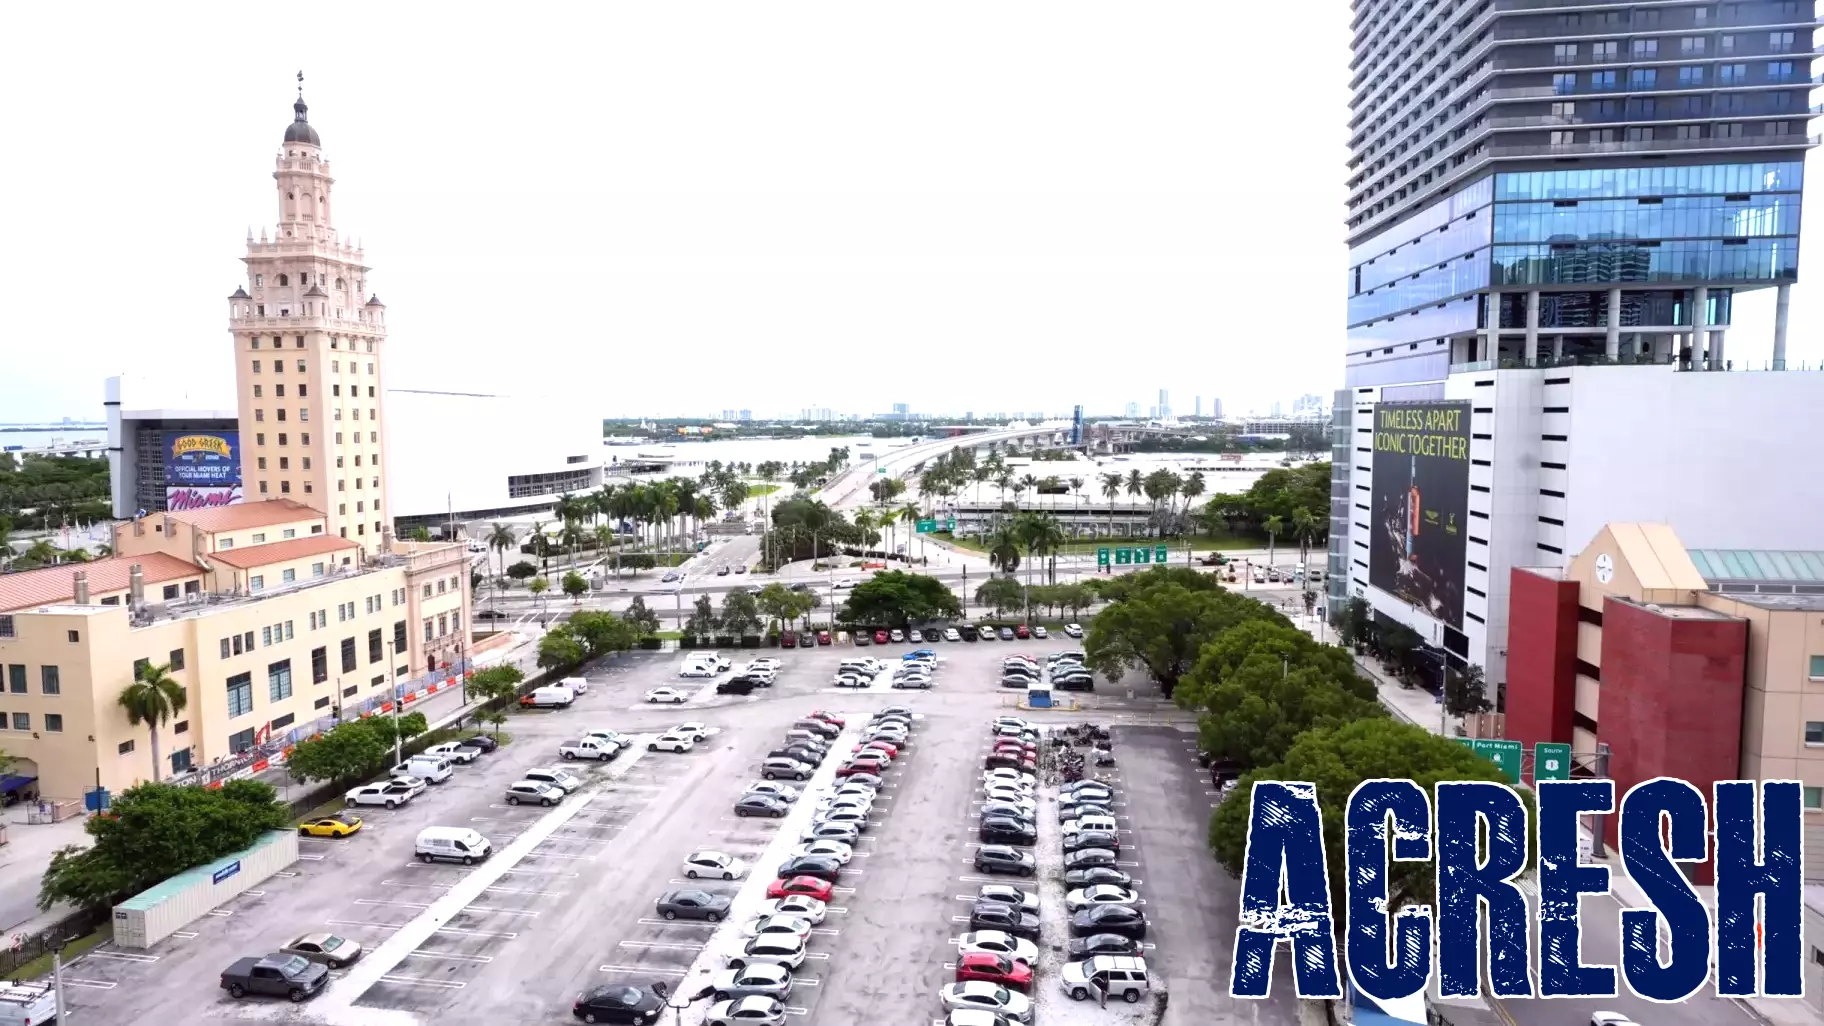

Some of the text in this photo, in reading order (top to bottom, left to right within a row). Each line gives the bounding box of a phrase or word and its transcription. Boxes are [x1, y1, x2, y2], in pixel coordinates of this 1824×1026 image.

[1380, 409, 1462, 432] TIMELESS APART
[178, 437, 224, 451] GOOD GREEK
[1375, 432, 1467, 460] ICONIC TOGETHER
[168, 485, 242, 511] Miami
[1494, 742, 1518, 750] Miami
